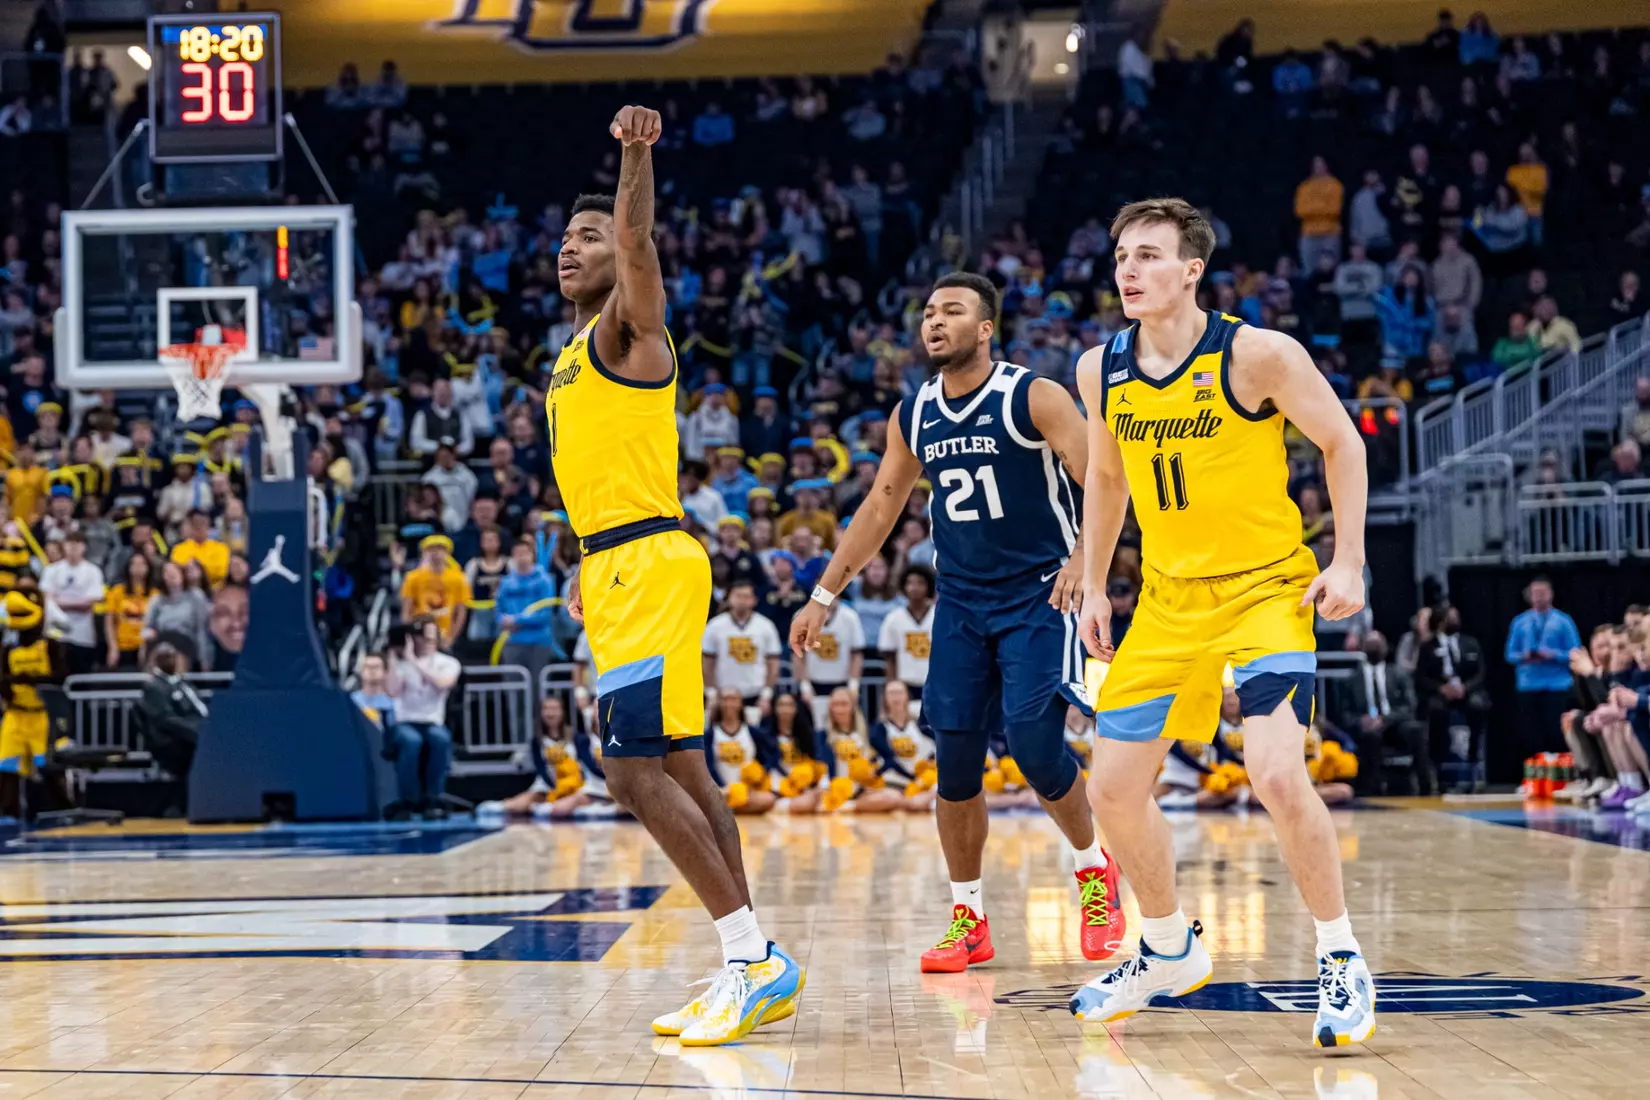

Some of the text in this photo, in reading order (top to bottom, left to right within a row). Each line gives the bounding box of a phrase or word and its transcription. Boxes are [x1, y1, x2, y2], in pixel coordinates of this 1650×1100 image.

[180, 25, 264, 62] 18:20
[181, 62, 254, 122] 30
[924, 436, 1000, 463] BUTLER
[1112, 408, 1223, 448] Marquette
[938, 464, 1005, 522] 21
[1150, 452, 1189, 511] 11
